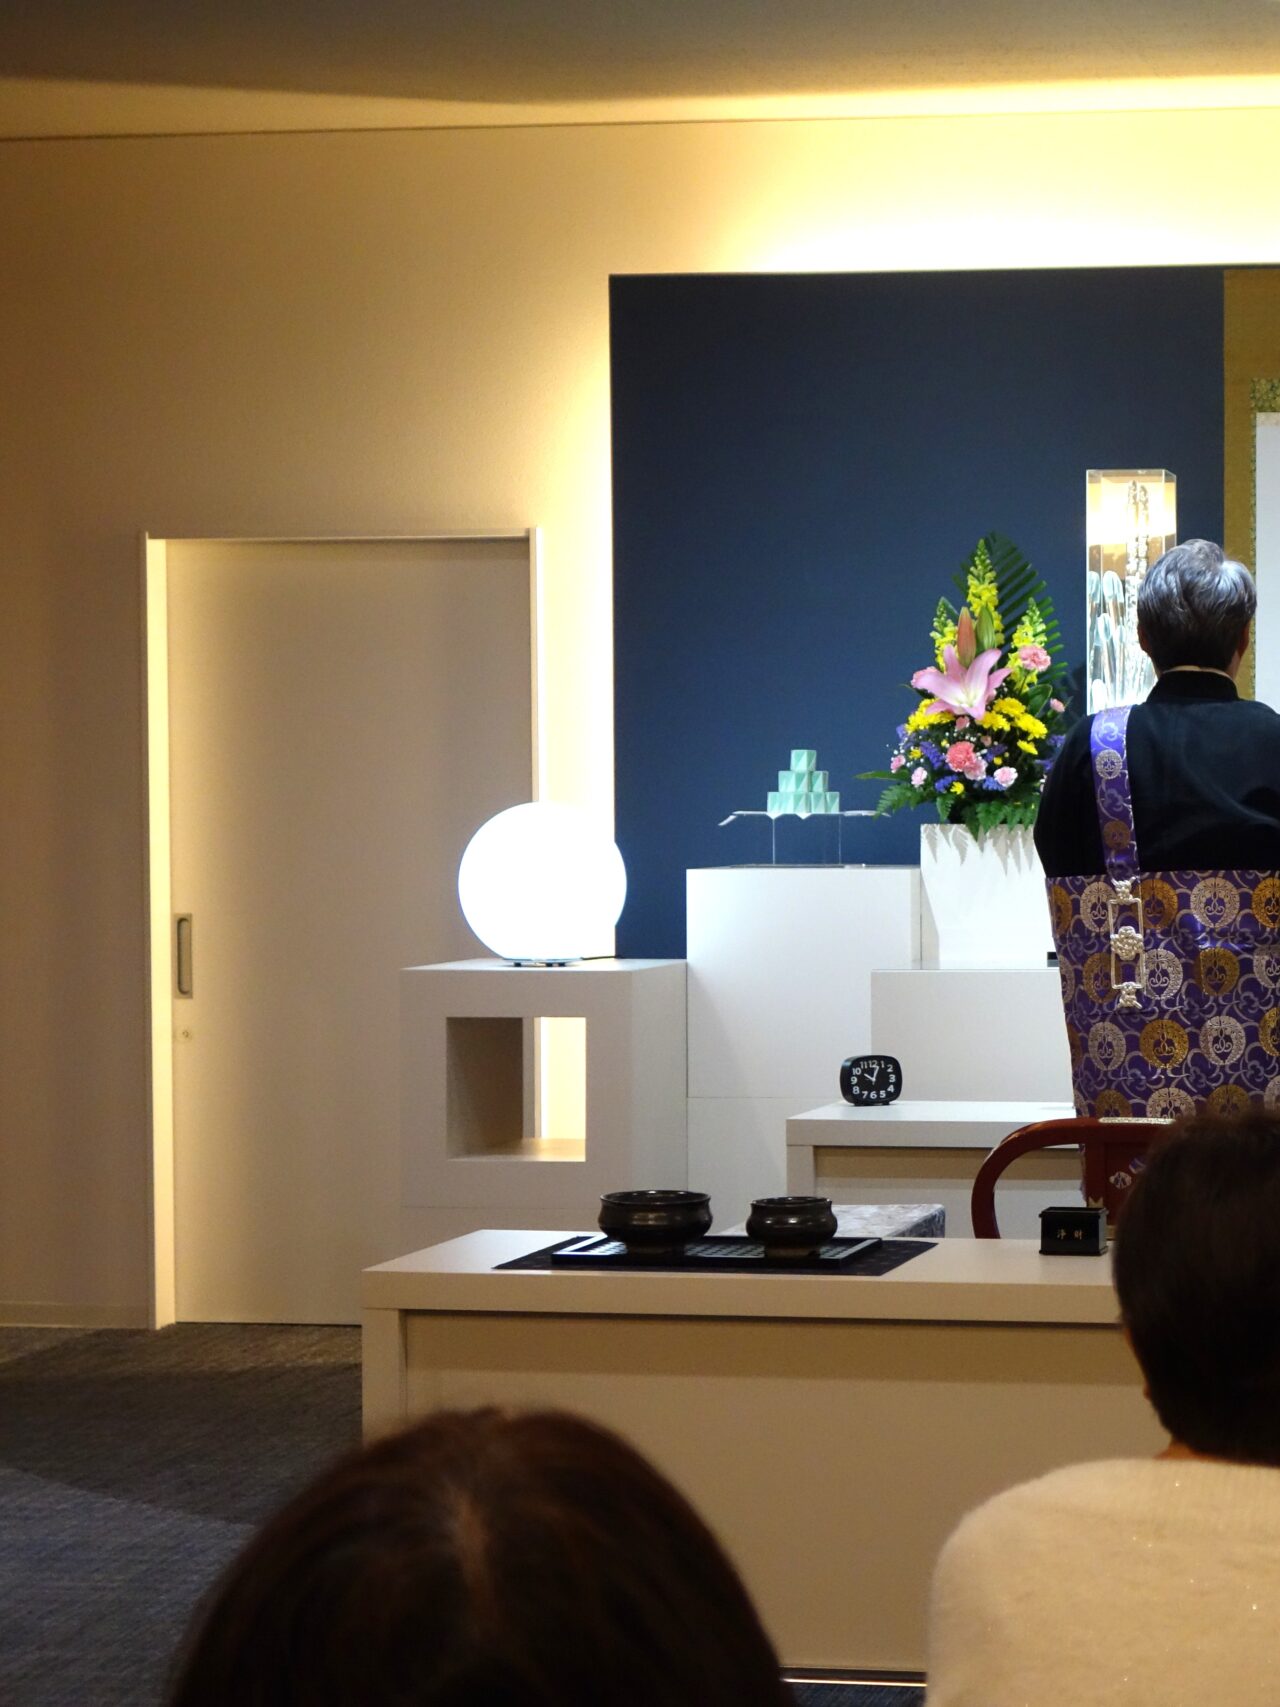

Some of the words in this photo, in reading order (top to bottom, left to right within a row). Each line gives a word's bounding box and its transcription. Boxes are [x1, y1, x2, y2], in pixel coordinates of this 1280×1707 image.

[860, 1061, 868, 1069] 11
[887, 1064, 894, 1072] 2
[850, 1076, 858, 1085] 9
[889, 1075, 896, 1083] 3
[852, 1086, 860, 1095] 8
[887, 1085, 895, 1093] 4
[862, 1091, 868, 1099] 7
[870, 1091, 877, 1099] 6
[879, 1090, 886, 1098] 5
